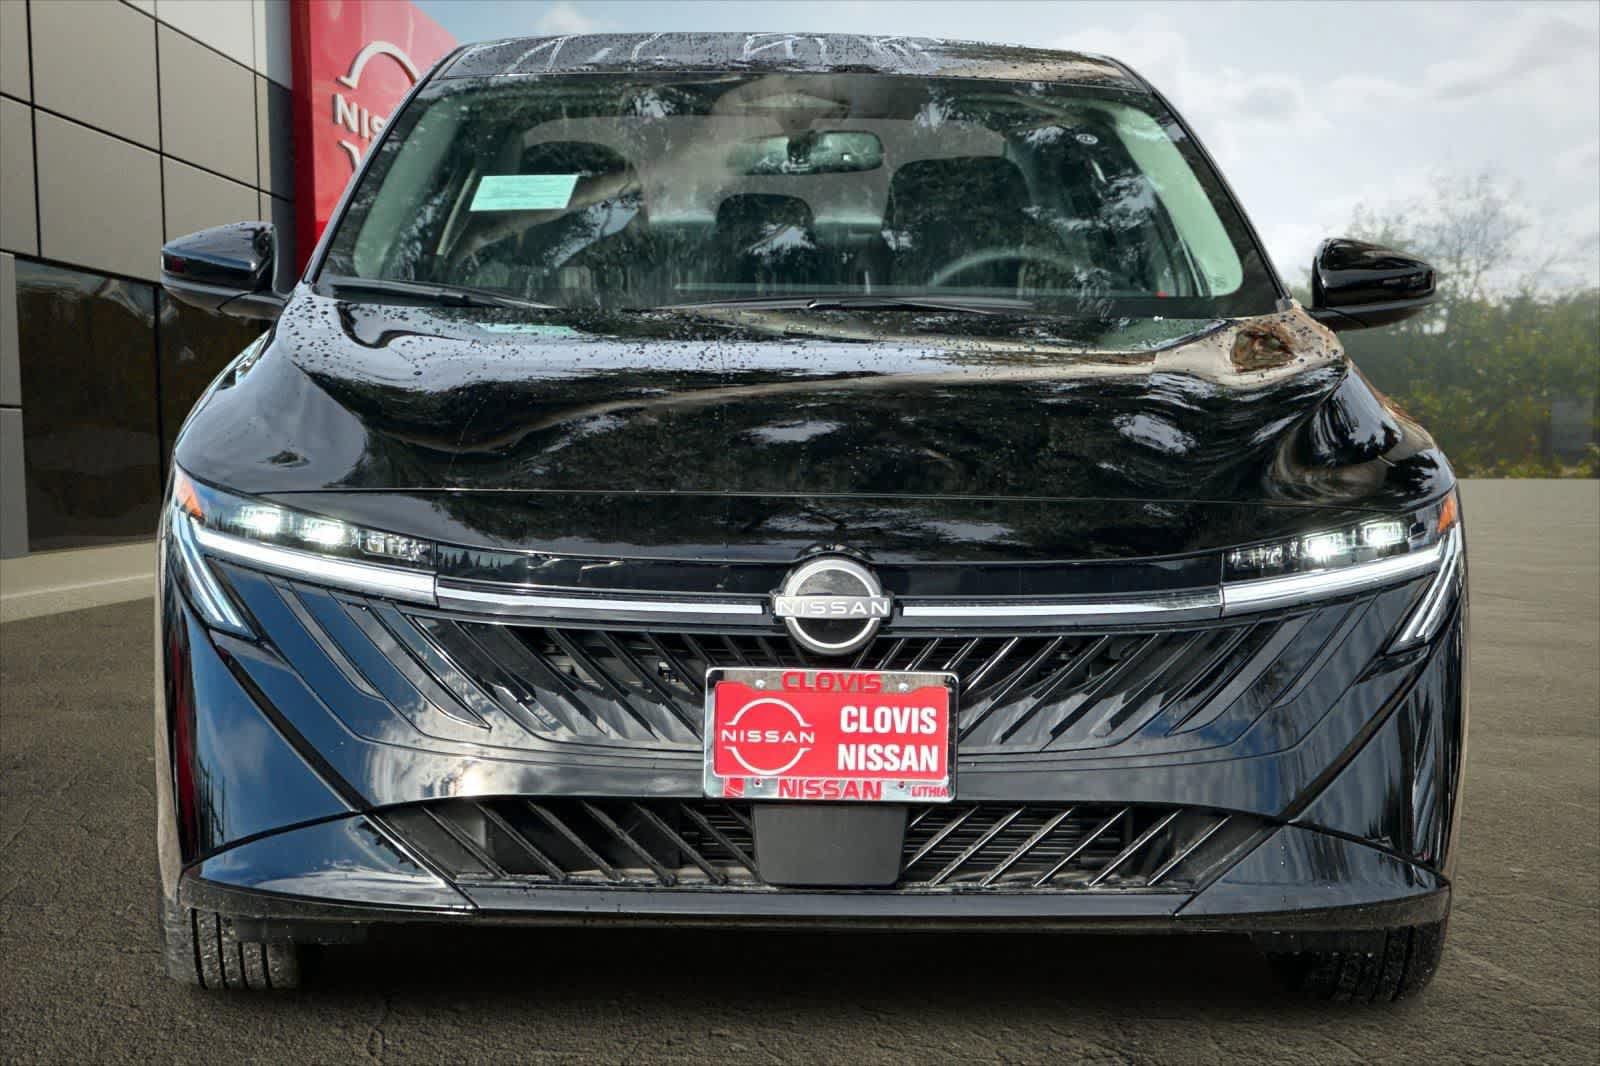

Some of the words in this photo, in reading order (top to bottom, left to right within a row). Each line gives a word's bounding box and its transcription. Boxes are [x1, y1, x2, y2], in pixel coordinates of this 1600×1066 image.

[779, 600, 888, 616] NISSAN
[782, 671, 883, 692] CLOVIS
[840, 705, 938, 735] CLOVIS
[721, 729, 816, 744] NISSAN
[837, 743, 940, 772] NISSAN
[778, 779, 882, 799] NISSAN
[910, 785, 950, 798] LITHIA
